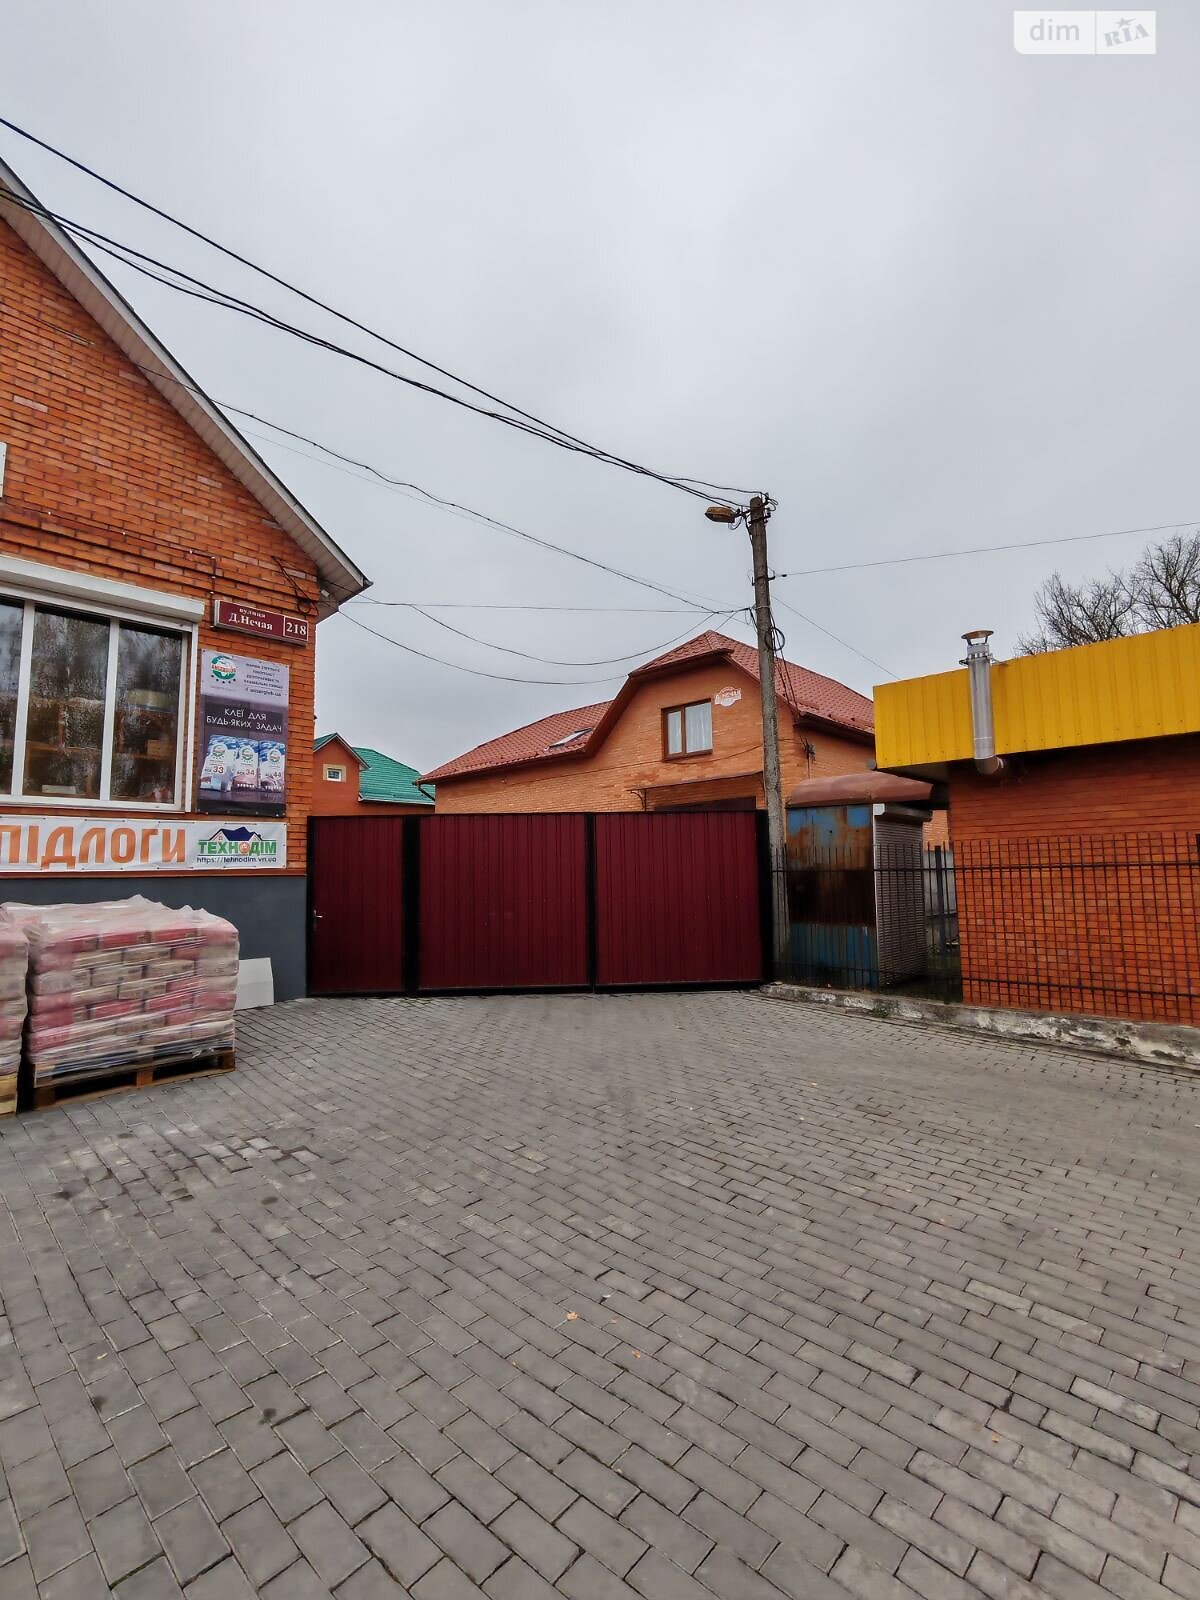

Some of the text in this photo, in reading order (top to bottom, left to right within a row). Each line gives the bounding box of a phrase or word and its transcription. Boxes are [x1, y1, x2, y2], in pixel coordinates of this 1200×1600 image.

[228, 612, 273, 631] Д.Нечая
[286, 622, 307, 636] 218
[224, 708, 267, 720] КЛЕЇ ДЛЯ
[206, 715, 282, 733] БУДЬ-ЯКИХ ЗАДАЧ
[212, 765, 224, 774] 33
[0, 824, 186, 871] ПІДЛОГИ
